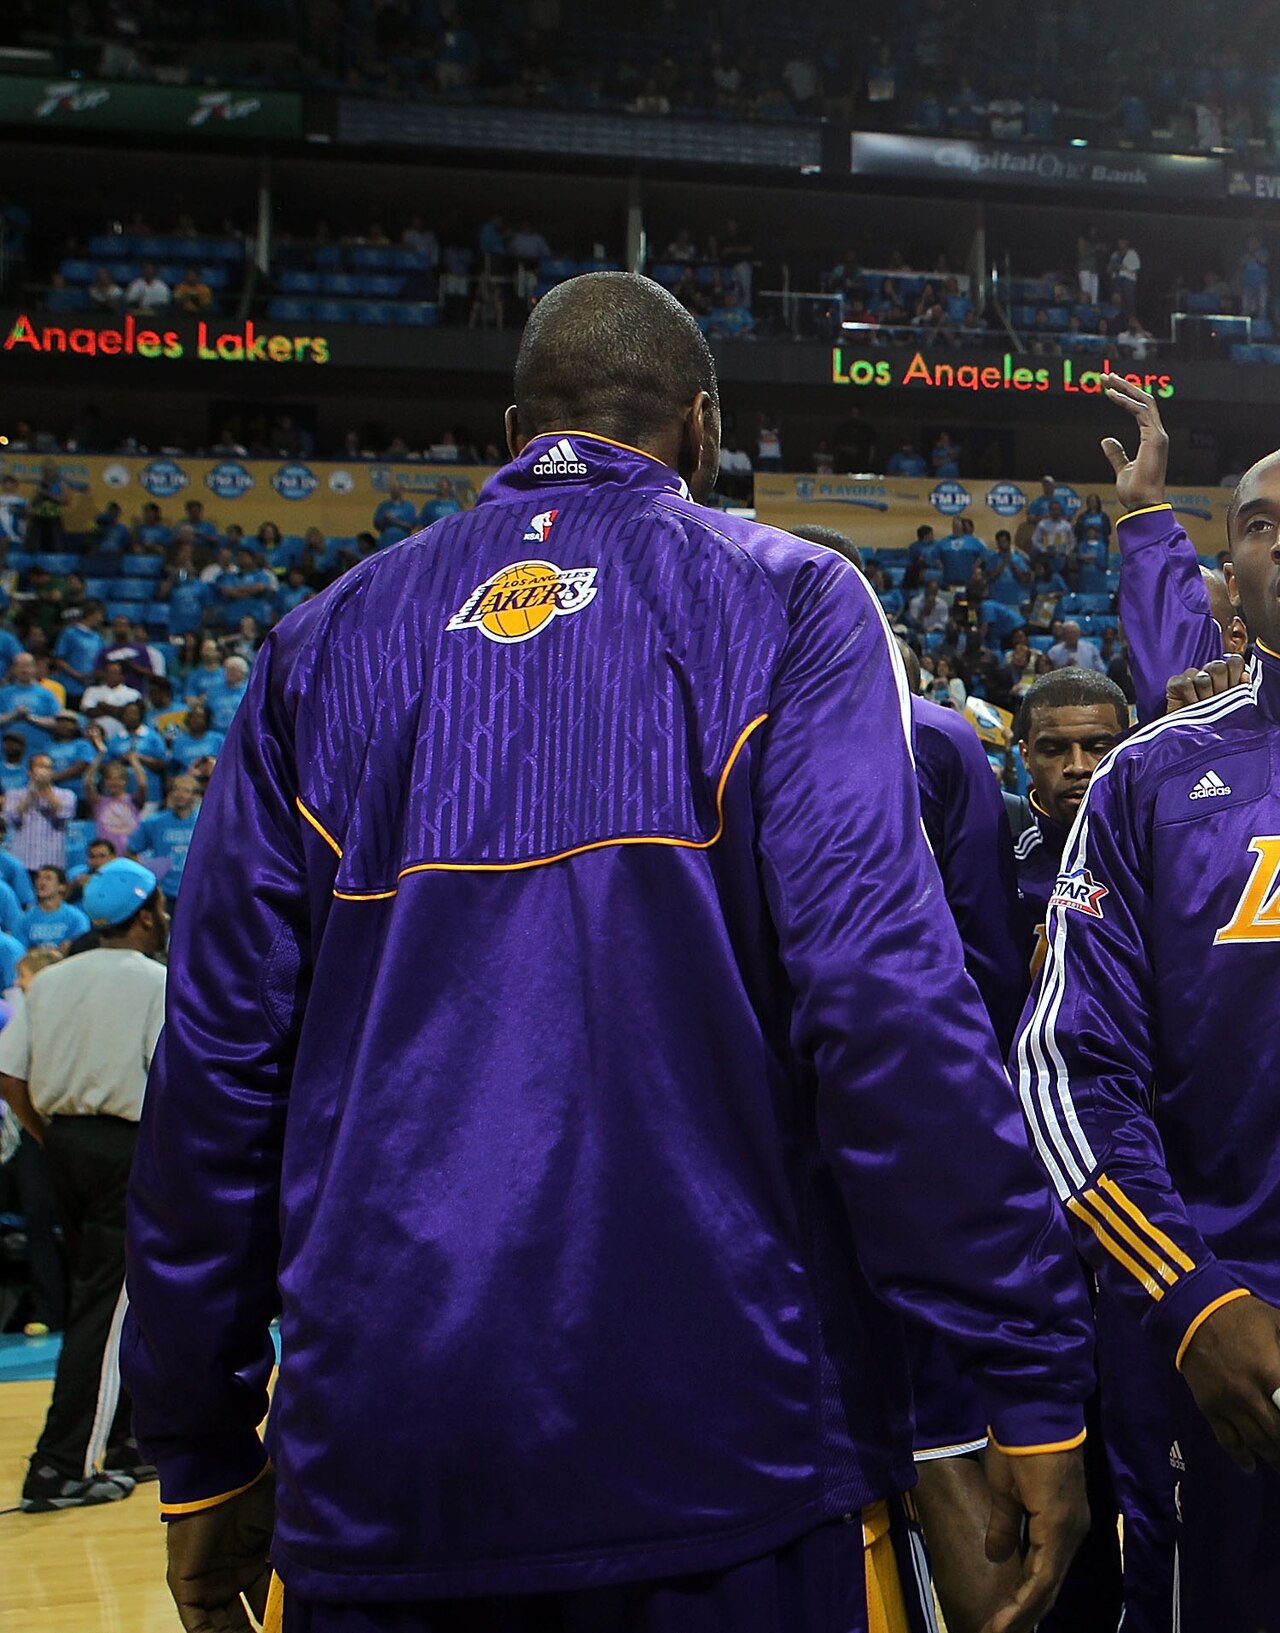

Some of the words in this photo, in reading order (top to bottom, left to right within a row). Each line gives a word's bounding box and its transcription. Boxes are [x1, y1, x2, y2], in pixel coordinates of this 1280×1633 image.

[1092, 165, 1147, 184] Bank
[3, 314, 183, 357] Angeles
[197, 319, 330, 363] Lakers
[832, 347, 891, 386] Los
[902, 352, 1050, 391] Angeles
[533, 461, 587, 475] adidas
[819, 484, 886, 497] PLAYOFFS
[502, 579, 525, 589] LOS
[526, 571, 591, 585] ANGELES
[462, 580, 588, 623] LAKERS
[1189, 785, 1231, 800] adidas
